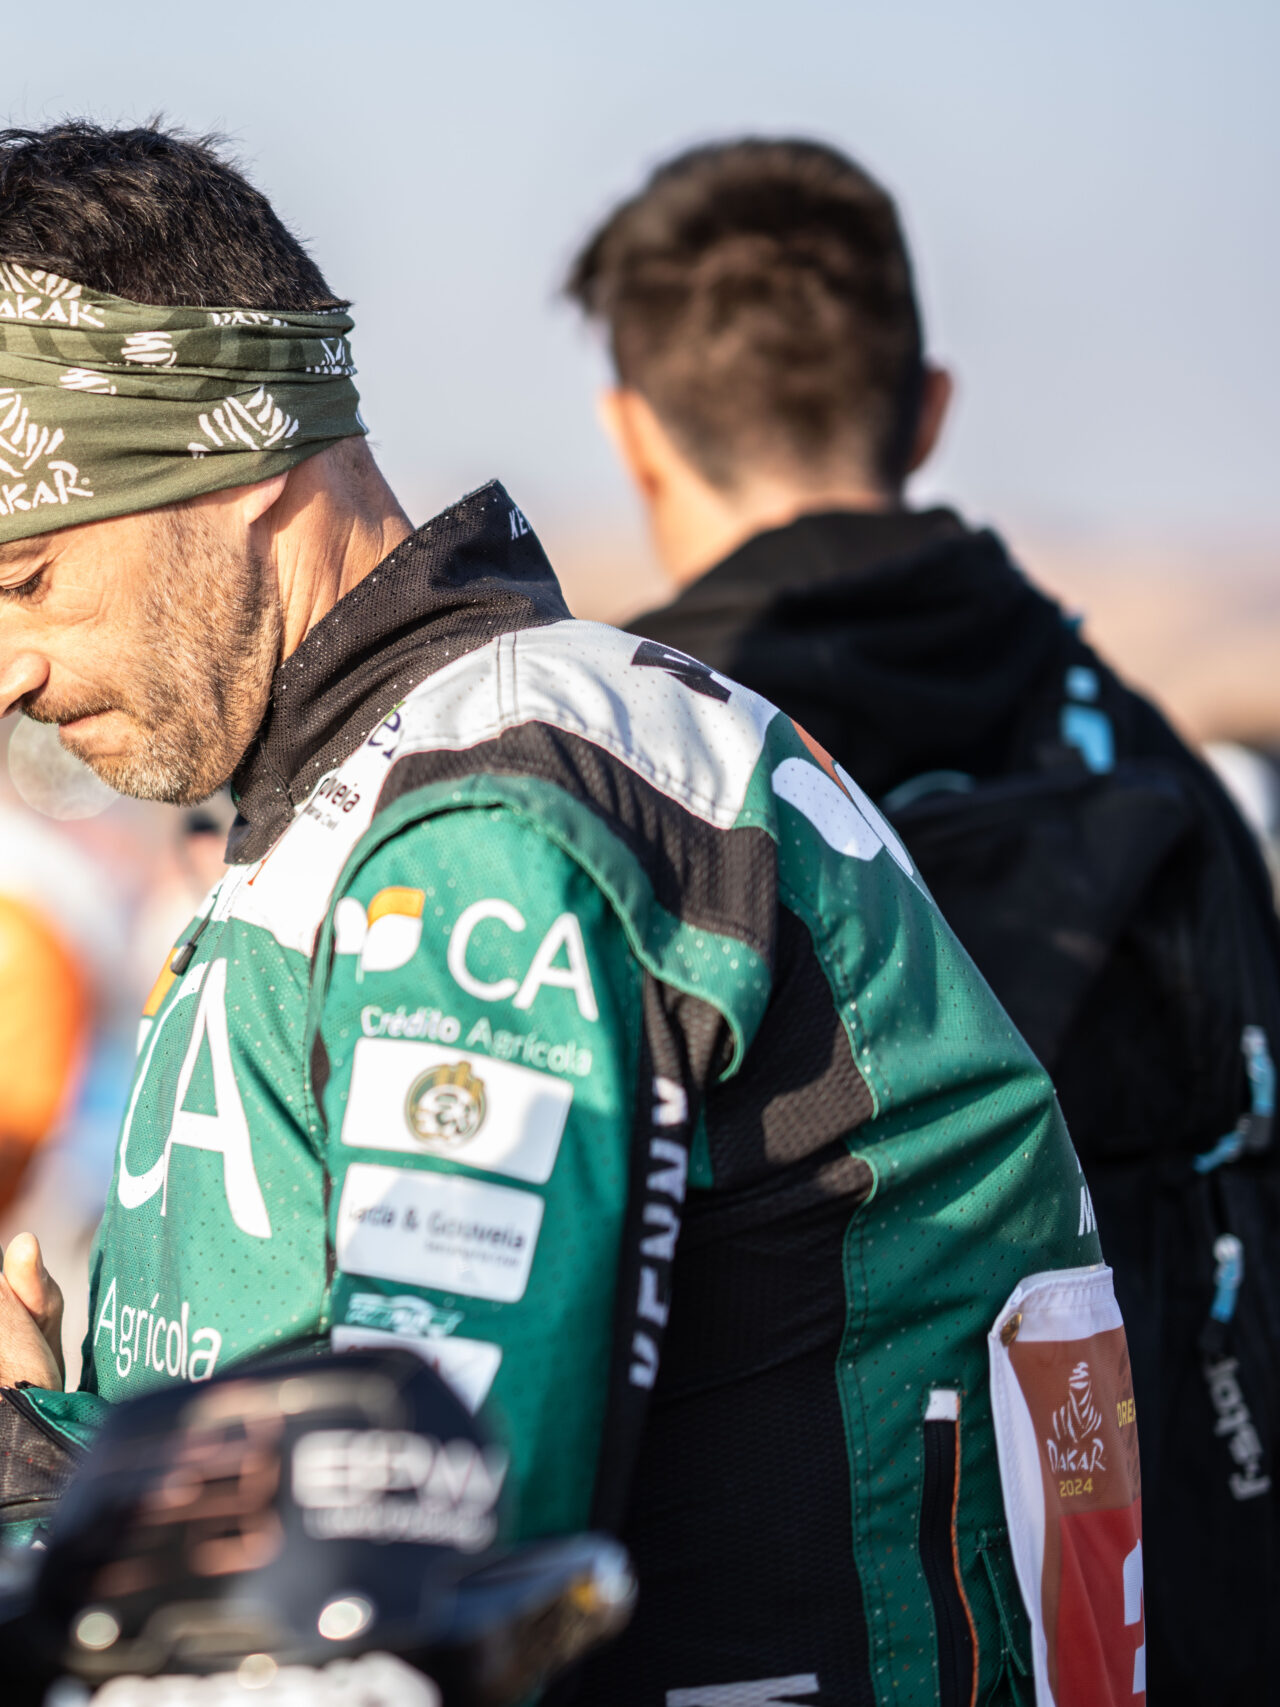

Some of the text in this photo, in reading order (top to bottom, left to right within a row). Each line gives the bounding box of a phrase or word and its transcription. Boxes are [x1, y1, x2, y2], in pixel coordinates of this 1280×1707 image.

[446, 898, 600, 1023] CA
[360, 1004, 462, 1045] Crédito
[118, 957, 272, 1240] CA
[94, 1276, 222, 1385] Agrícola
[1116, 1398, 1137, 1429] DRE
[1046, 1437, 1107, 1474] DAKAR
[1059, 1477, 1094, 1498] 2024
